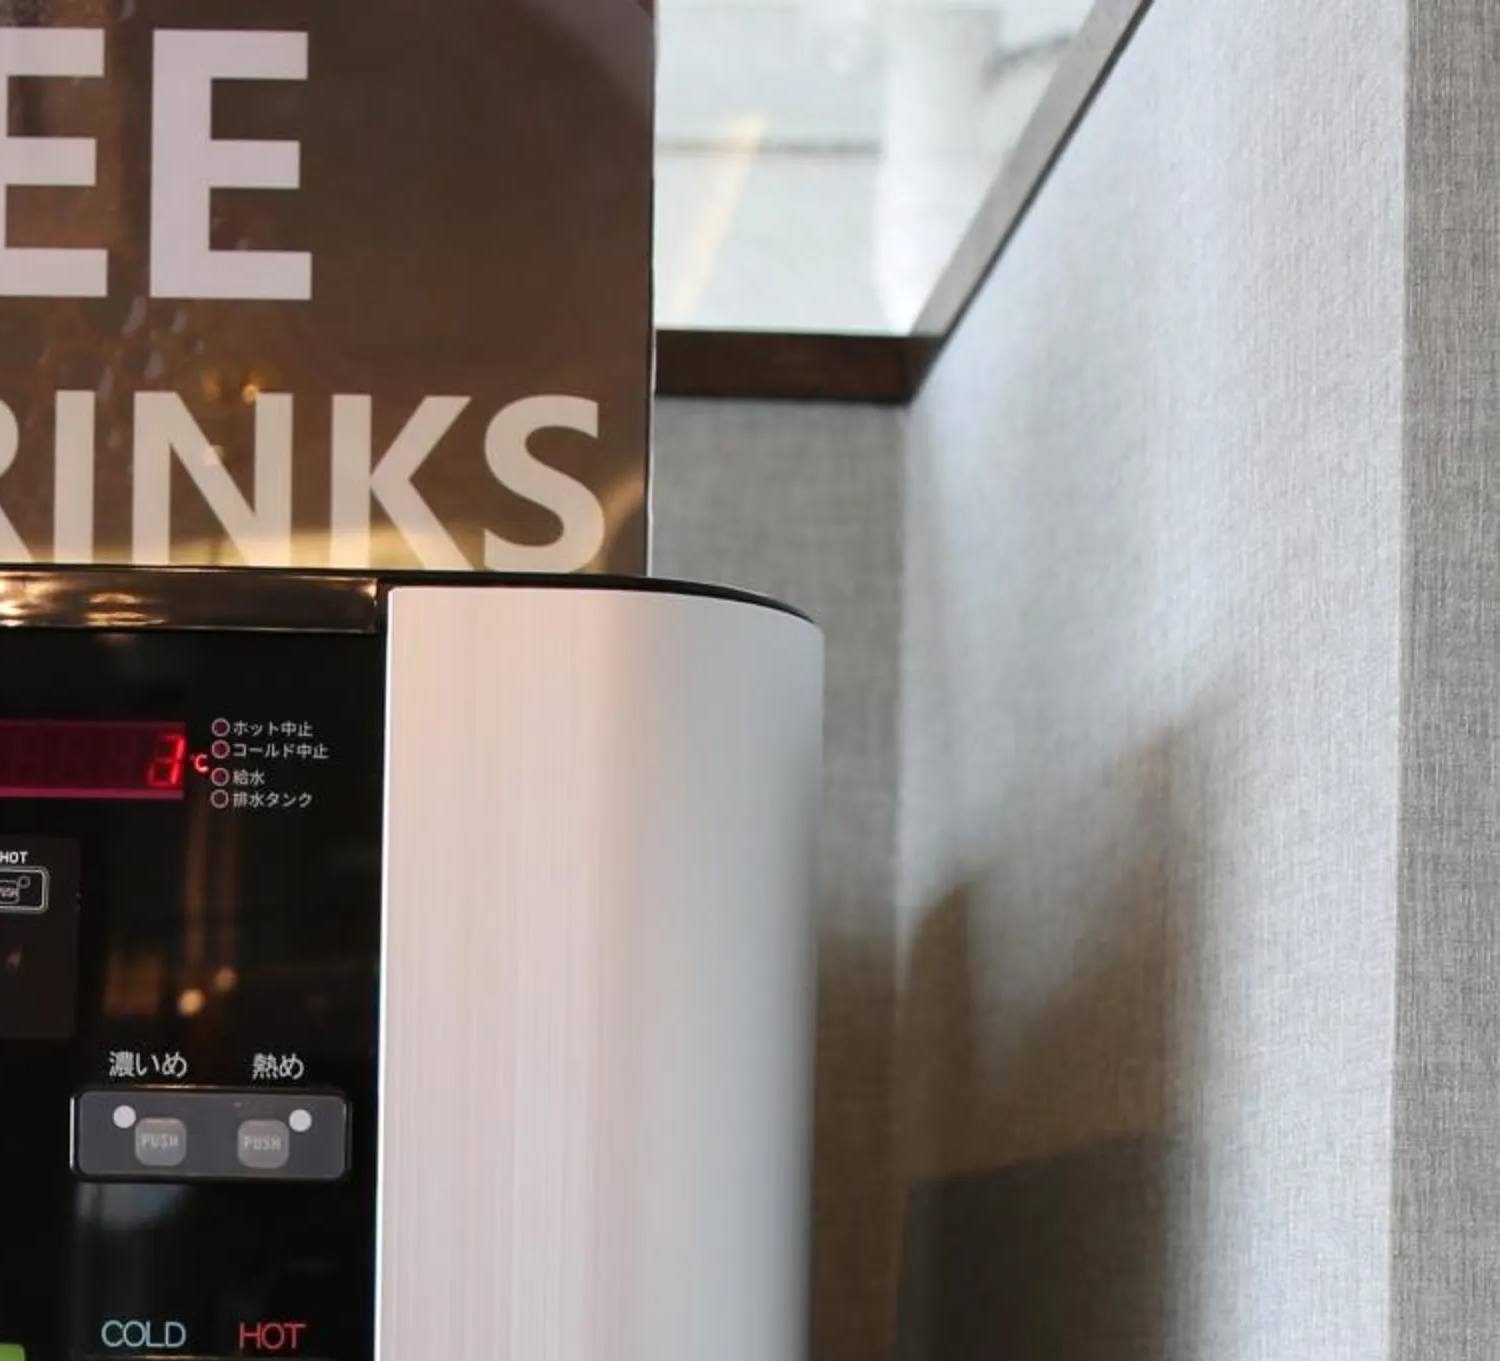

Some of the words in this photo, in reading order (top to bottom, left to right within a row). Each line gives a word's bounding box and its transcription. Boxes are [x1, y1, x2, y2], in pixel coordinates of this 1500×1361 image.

[233, 720, 313, 737] ホット中止
[232, 743, 329, 759] コールド中止
[232, 791, 313, 808] 排水タンク
[0, 851, 28, 864] HOT
[109, 1051, 187, 1078] 濃いめ
[252, 1053, 304, 1080] 熱め
[141, 1133, 179, 1147] PUSH
[243, 1137, 281, 1150] PUSH
[101, 1320, 187, 1347] COLD
[239, 1322, 306, 1349] HOT
